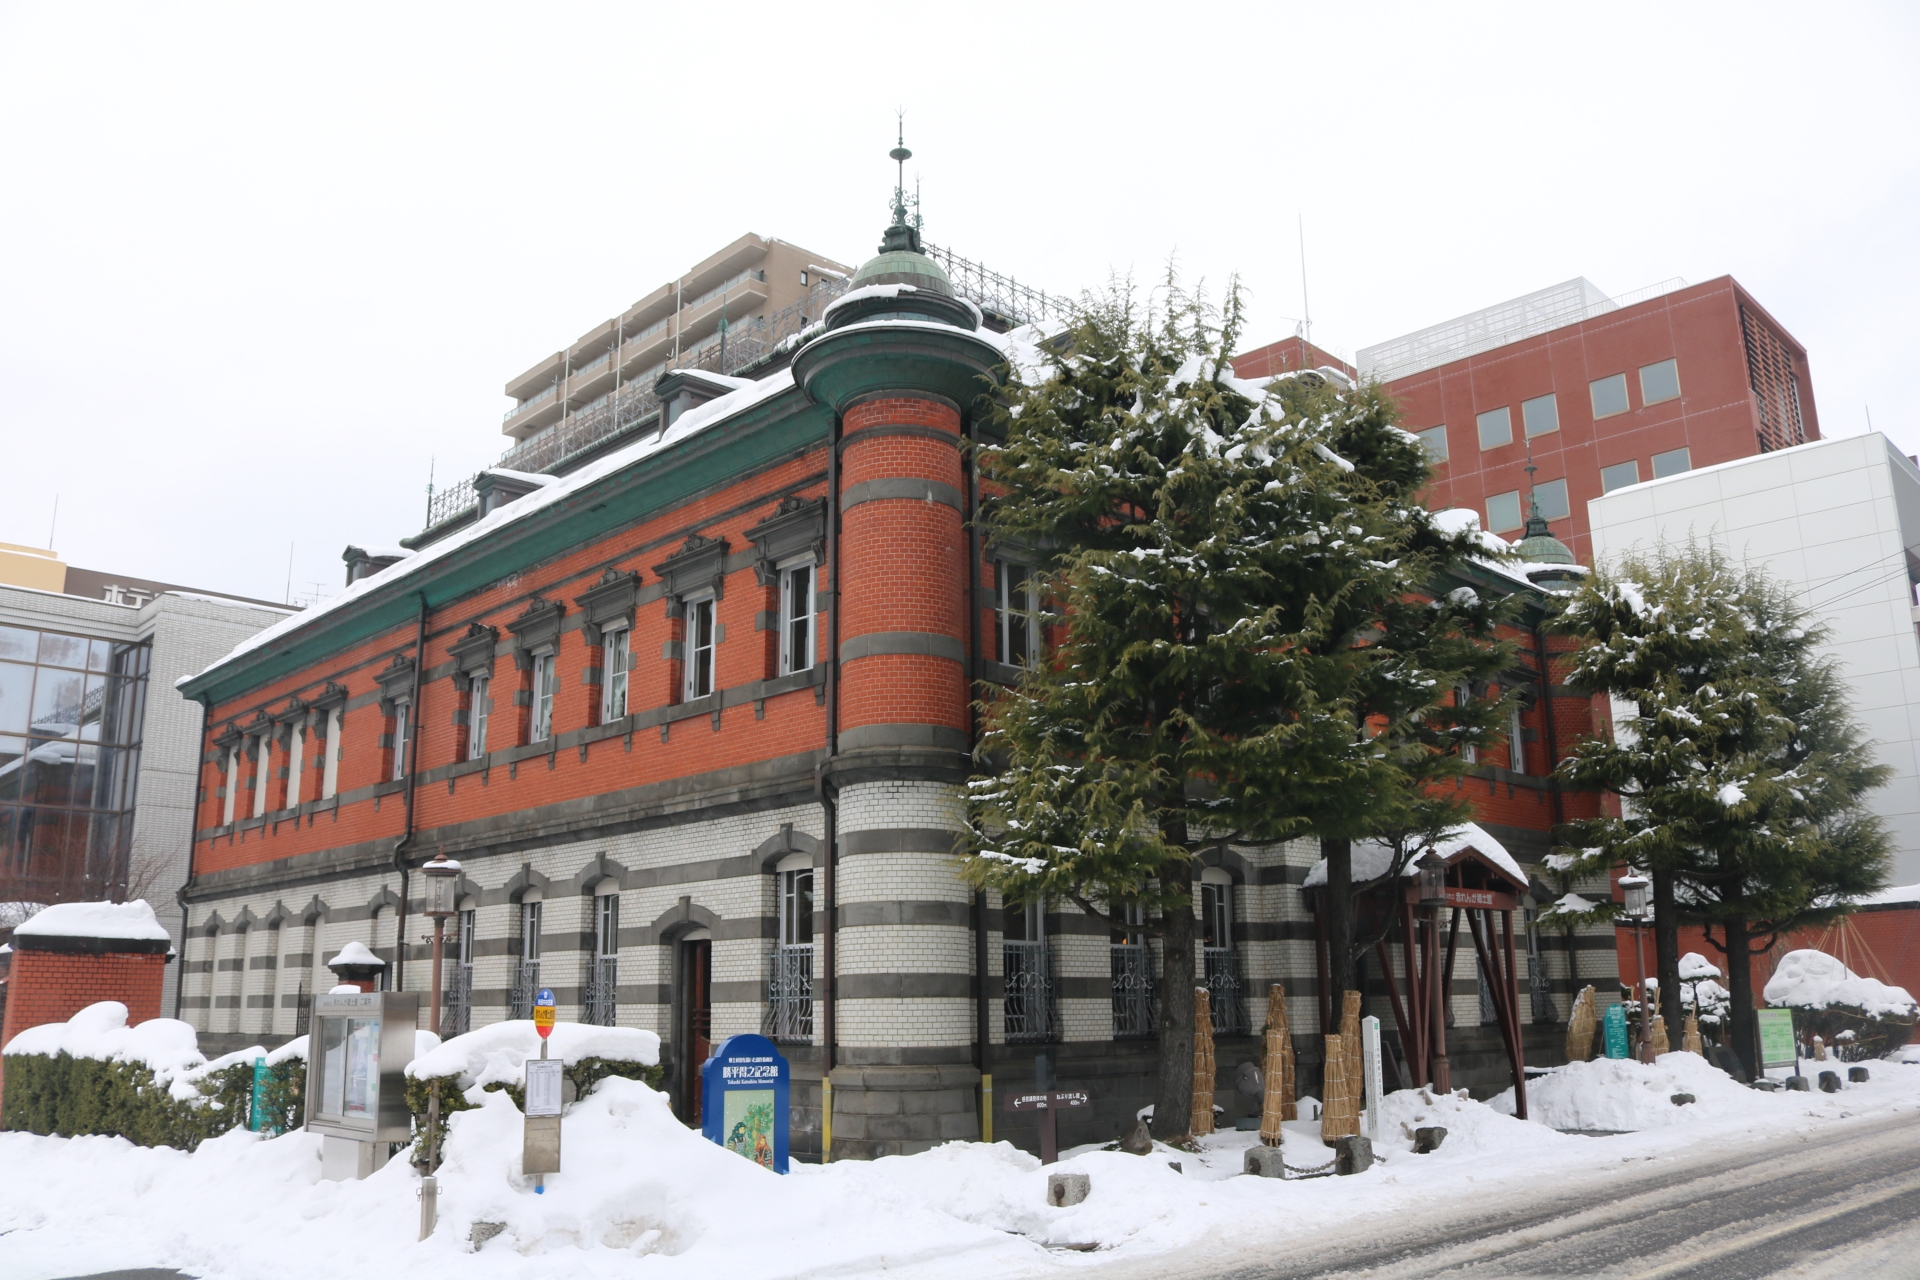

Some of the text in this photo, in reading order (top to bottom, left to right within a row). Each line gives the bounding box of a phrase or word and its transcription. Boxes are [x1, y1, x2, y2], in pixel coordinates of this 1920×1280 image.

[103, 584, 160, 606] ホテ
[1456, 892, 1492, 904] 赤れんが郷土館
[723, 1066, 778, 1078] 勝平得之記念館
